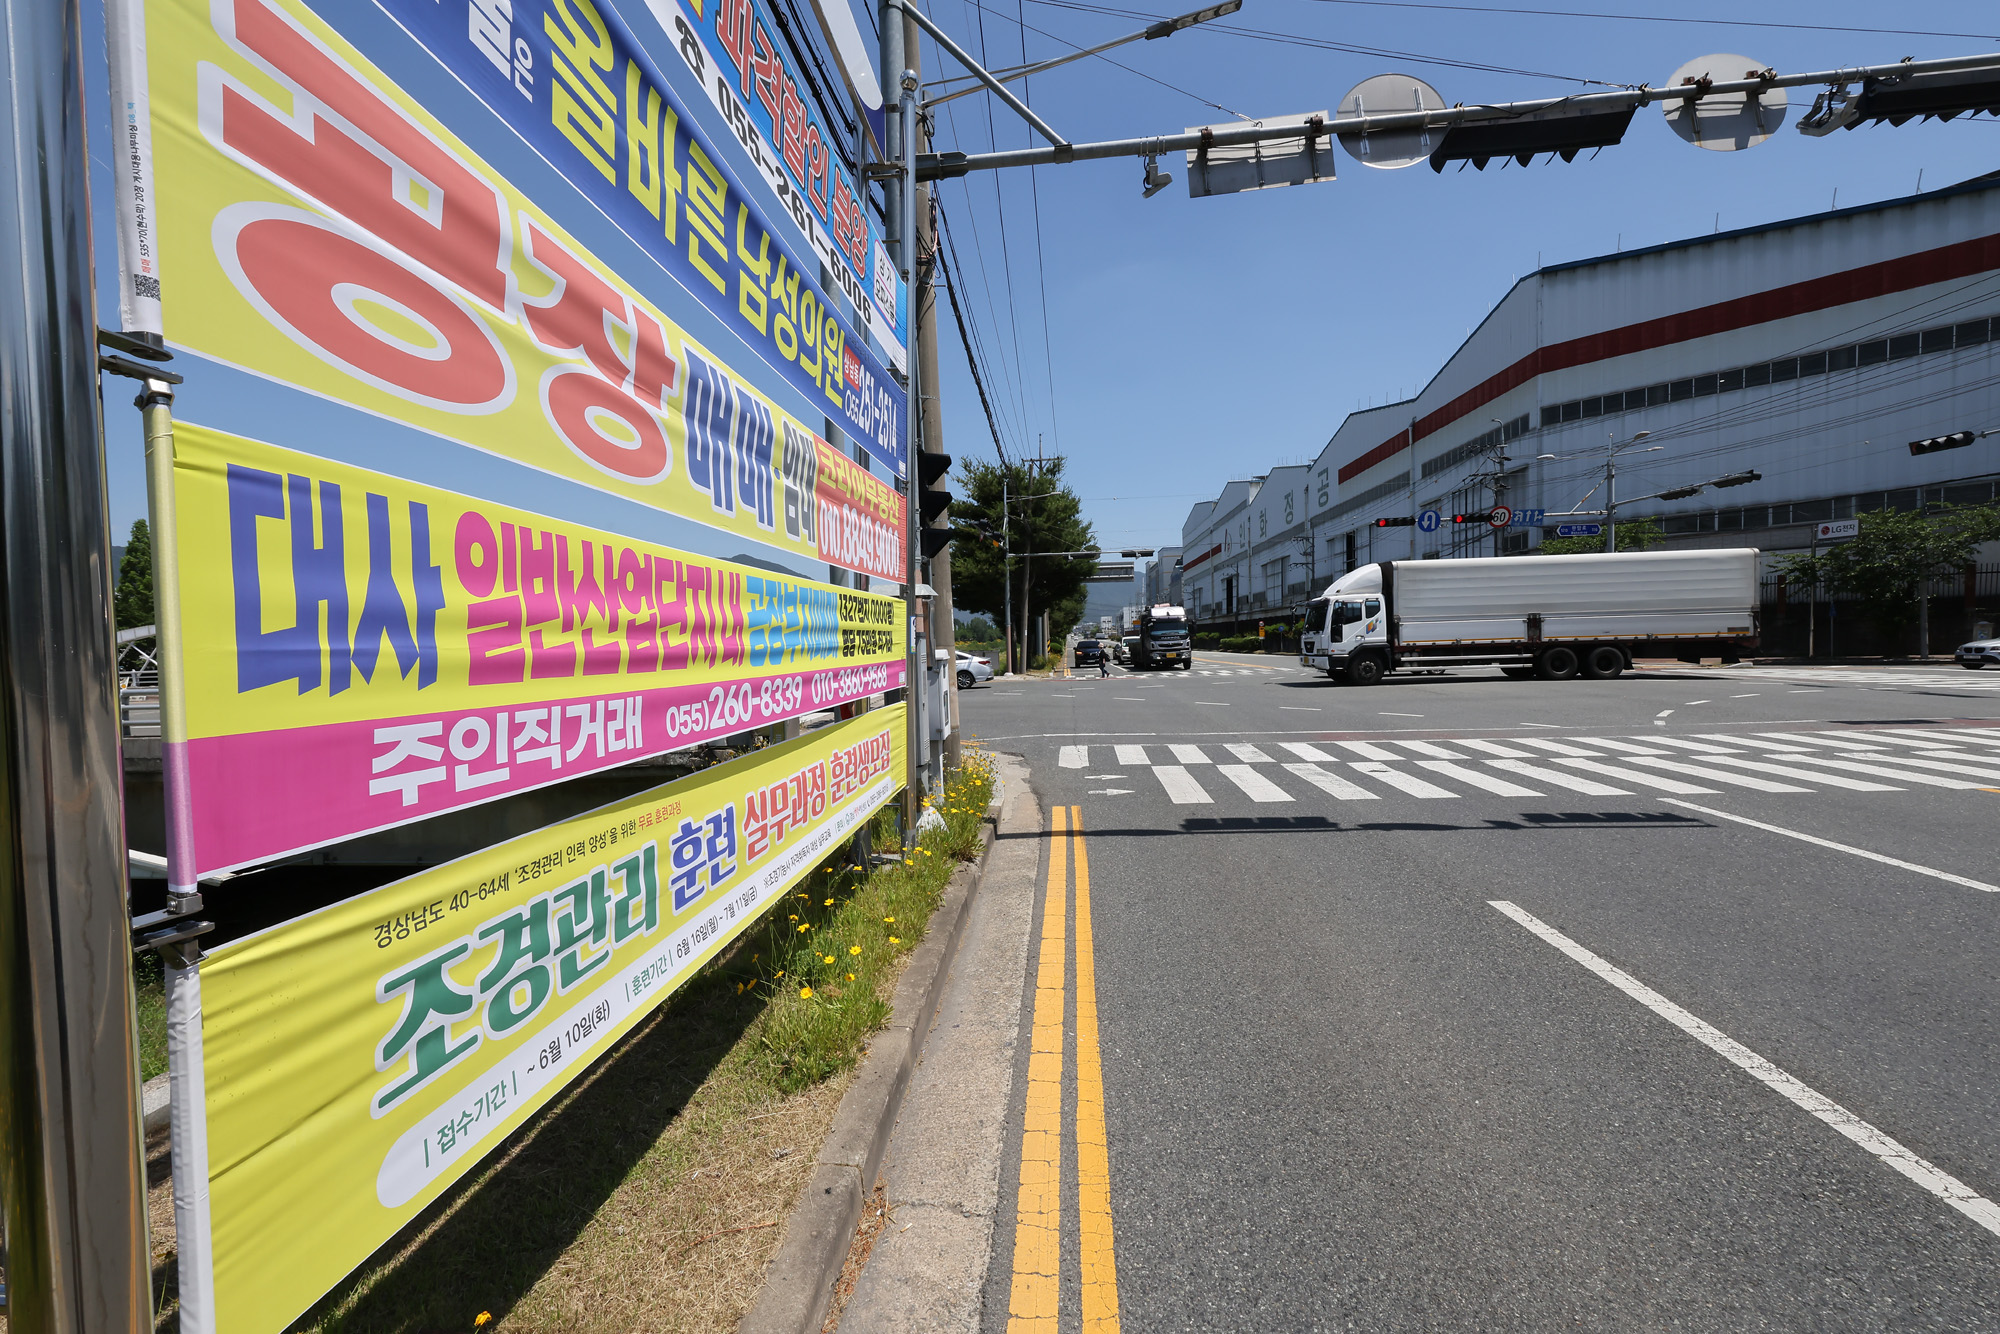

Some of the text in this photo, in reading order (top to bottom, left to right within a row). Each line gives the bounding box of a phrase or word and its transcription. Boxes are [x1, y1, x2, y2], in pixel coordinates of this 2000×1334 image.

[716, 0, 868, 280] 파격할인 분양
[718, 76, 872, 325] 055-261-6006
[222, 0, 676, 478] 공장
[844, 352, 860, 385] 상남동
[226, 462, 446, 697] 대사
[817, 442, 900, 526] 코리아부동산
[820, 499, 900, 578] 010.8849.9000
[1493, 511, 1506, 522] 60
[369, 695, 644, 807] 주인직거래
[811, 664, 888, 704] 010-3860-9568
[374, 899, 446, 949] 경상남도
[449, 872, 510, 912] 40-64세
[566, 840, 586, 863] 인력
[619, 818, 637, 840] 위한
[638, 813, 654, 831] 무료
[655, 800, 682, 824] 훈련과정
[378, 845, 657, 1109] 조경관리
[670, 806, 736, 911] 훈련
[744, 762, 826, 861] 실무과정
[830, 730, 890, 805] 훈련생모집
[437, 1079, 508, 1155] 접수기간
[539, 1040, 561, 1071] 6월
[564, 999, 612, 1047] 10일(화)
[632, 954, 668, 1000] 훈련기간
[676, 938, 691, 959] 6월
[691, 918, 719, 949] 16일(월)
[724, 904, 736, 922] 7월
[735, 885, 758, 914] 11일(금)
